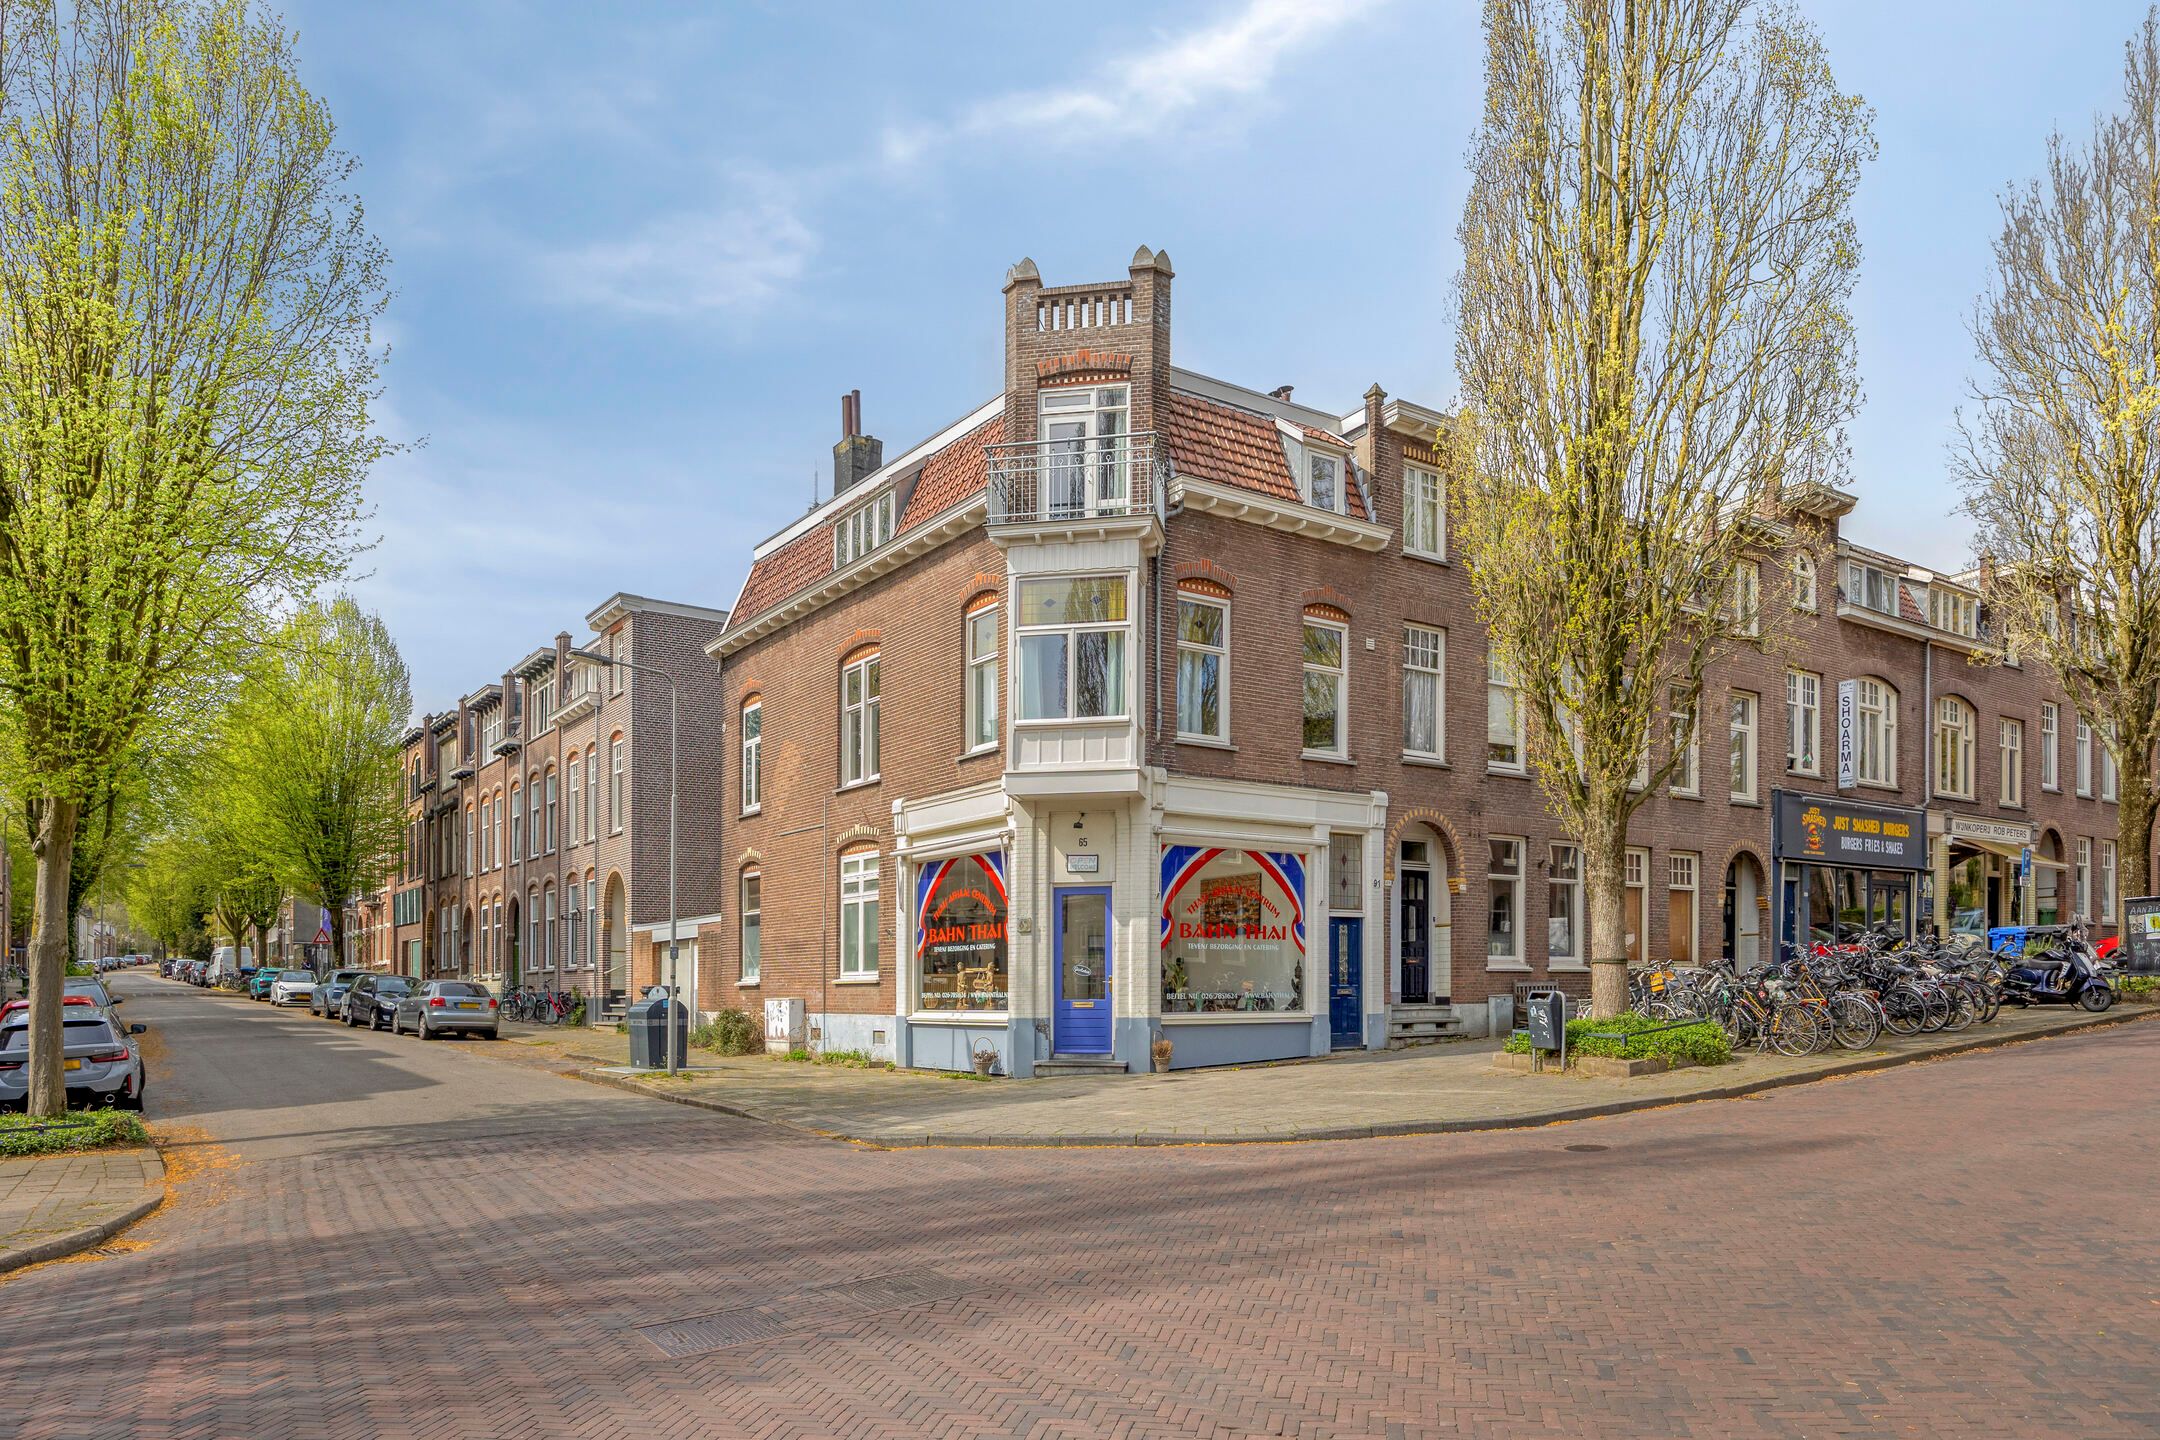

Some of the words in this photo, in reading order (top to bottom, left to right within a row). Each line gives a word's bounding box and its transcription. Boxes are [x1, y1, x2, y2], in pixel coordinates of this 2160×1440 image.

[1841, 696, 1852, 774] SHOARMA
[1832, 815, 1850, 831] JUST
[1852, 817, 1880, 834] SMASHED
[1883, 821, 1910, 838] BURGERS
[1993, 826, 2006, 836] ROB
[2006, 827, 2027, 838] PETERS
[1079, 837, 1088, 847] 65
[1841, 836, 1863, 851] BURGERS
[1864, 838, 1880, 853] FRIES
[1885, 840, 1904, 855] SHAKES
[1373, 879, 1381, 888] 91
[1245, 888, 1280, 918] CENTRUM
[2130, 904, 2160, 914] AANBIE
[929, 925, 966, 943] BAHN
[970, 923, 1002, 940] THAI
[1180, 922, 1237, 939] BAHN
[1243, 923, 1286, 940] THAI
[976, 942, 996, 950] CATERING
[1210, 943, 1243, 951] BEZORGING
[1253, 943, 1280, 951] CATERING
[1166, 992, 1187, 1000] BESTEL
